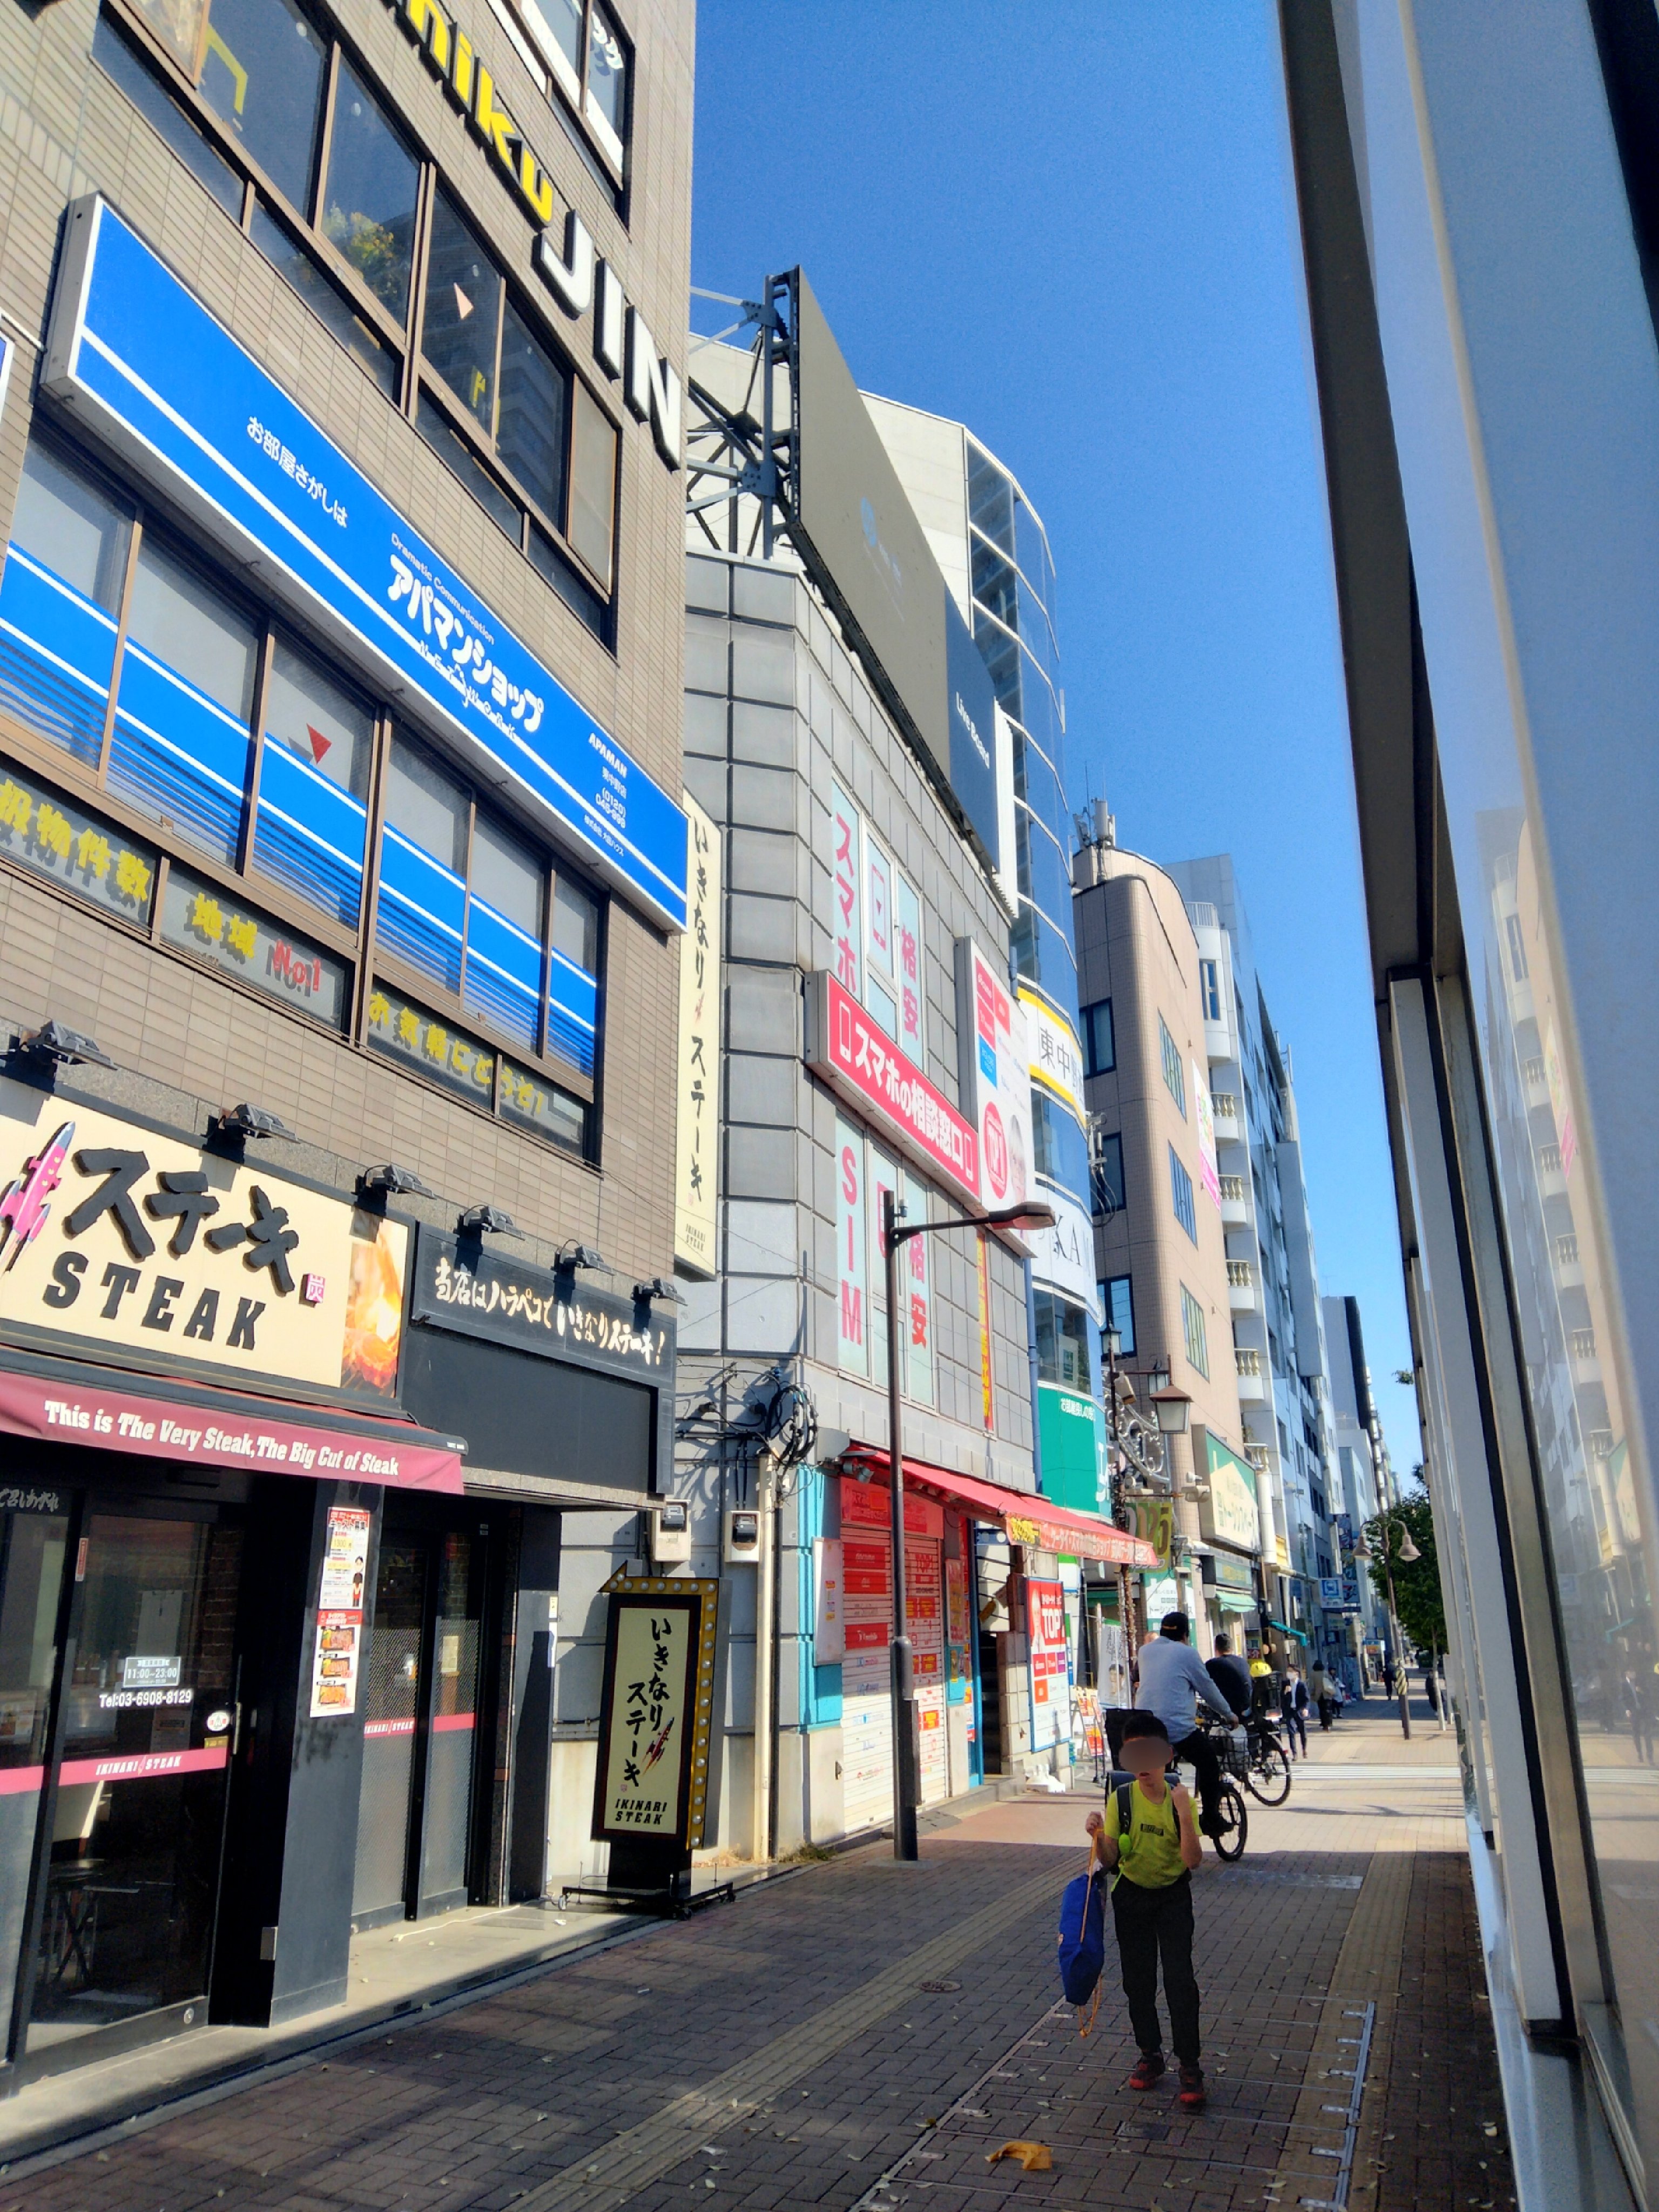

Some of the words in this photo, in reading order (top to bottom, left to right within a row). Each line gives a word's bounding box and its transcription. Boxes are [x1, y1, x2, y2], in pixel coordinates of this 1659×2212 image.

[248, 415, 347, 529] お部屋さがしは
[387, 554, 544, 733] アパマンショップ
[391, 532, 433, 581] Dramatic
[434, 577, 495, 645] Communication
[588, 732, 628, 779] APAMAN
[192, 892, 258, 959] 地域
[274, 939, 321, 992] No.1
[693, 815, 709, 989] いきなり
[835, 811, 856, 994] スマホ
[901, 923, 919, 1041] 格安
[690, 1035, 706, 1202] ステーキ
[854, 1022, 964, 1171] スマホの相談窓口
[62, 1148, 299, 1296] ステーキ
[841, 1145, 862, 1346] SIM
[42, 1251, 266, 1350] STEAK
[44, 1400, 90, 1429] This
[93, 1408, 113, 1434] is
[117, 1412, 156, 1440] The
[159, 1419, 202, 1452] Very
[203, 1426, 255, 1459] Steak,
[257, 1435, 288, 1461] The
[288, 1441, 317, 1469] Big
[318, 1446, 341, 1469] Cut
[344, 1451, 362, 1471] of
[359, 1456, 399, 1476] Steak
[648, 1617, 672, 1731] いきなり
[96, 1761, 138, 1776] IKINARI
[145, 1755, 182, 1770] STEAK
[624, 1681, 648, 1788] ステーキ
[615, 1798, 667, 1813] IKINARI
[615, 1811, 663, 1825] STEAK
